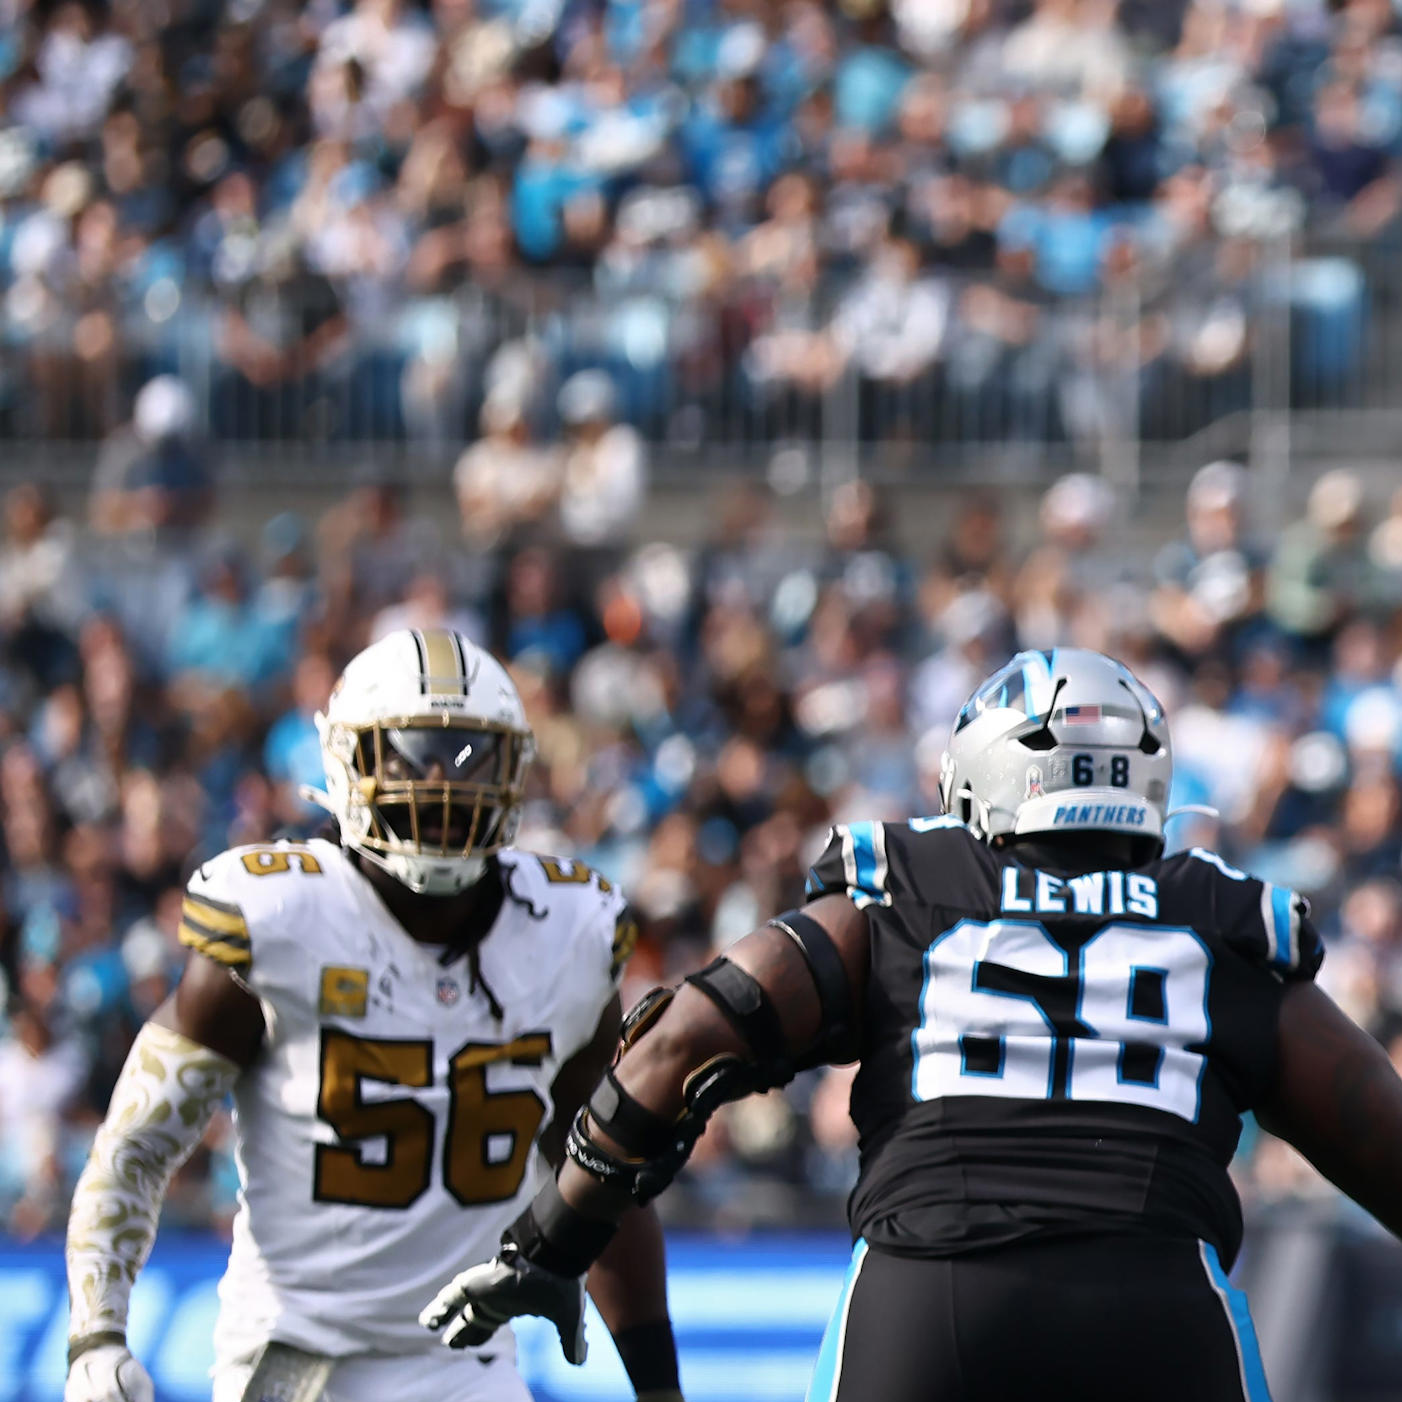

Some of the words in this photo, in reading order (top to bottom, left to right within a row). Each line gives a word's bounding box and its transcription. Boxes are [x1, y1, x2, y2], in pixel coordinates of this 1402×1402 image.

[1071, 753, 1130, 788] 68
[1053, 804, 1147, 826] PANTHERS
[1001, 865, 1159, 920] LEWIS
[911, 916, 1215, 1124] 68
[312, 1024, 554, 1210] 56
